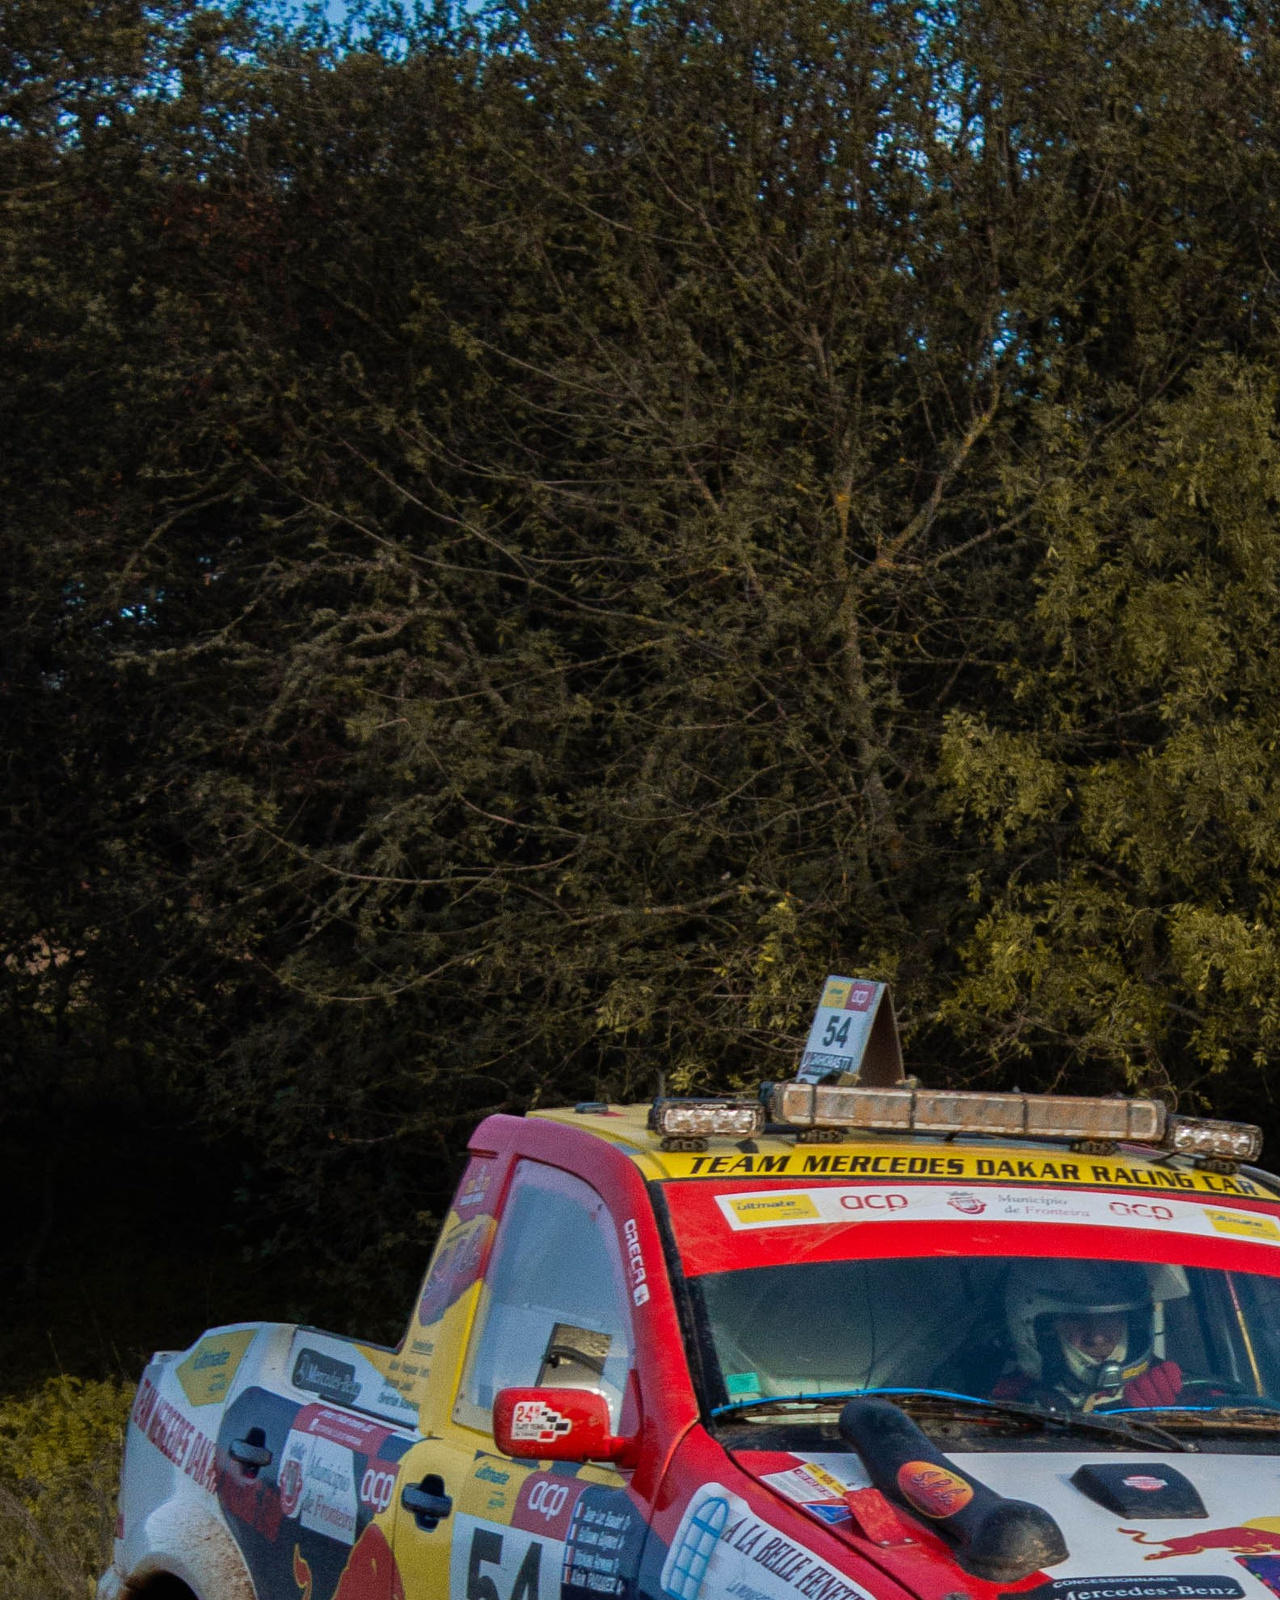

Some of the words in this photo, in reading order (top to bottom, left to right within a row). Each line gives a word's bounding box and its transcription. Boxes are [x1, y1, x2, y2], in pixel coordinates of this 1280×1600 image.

[822, 1015, 852, 1048] 54
[690, 1155, 791, 1174] TEAM
[802, 1155, 963, 1175] MERCEDES
[977, 1159, 1080, 1180] DAKAR
[1091, 1165, 1193, 1188] RACING
[1204, 1175, 1258, 1196] CAR
[840, 1194, 908, 1212] acp
[1004, 1205, 1020, 1215] de
[1025, 1207, 1091, 1217] Fronteira
[361, 1468, 395, 1512] acp
[528, 1481, 569, 1521] acp
[733, 1523, 769, 1556] LA
[753, 1536, 812, 1583] BELLE
[1052, 1576, 1178, 1589] CONCESSIONNAIRE
